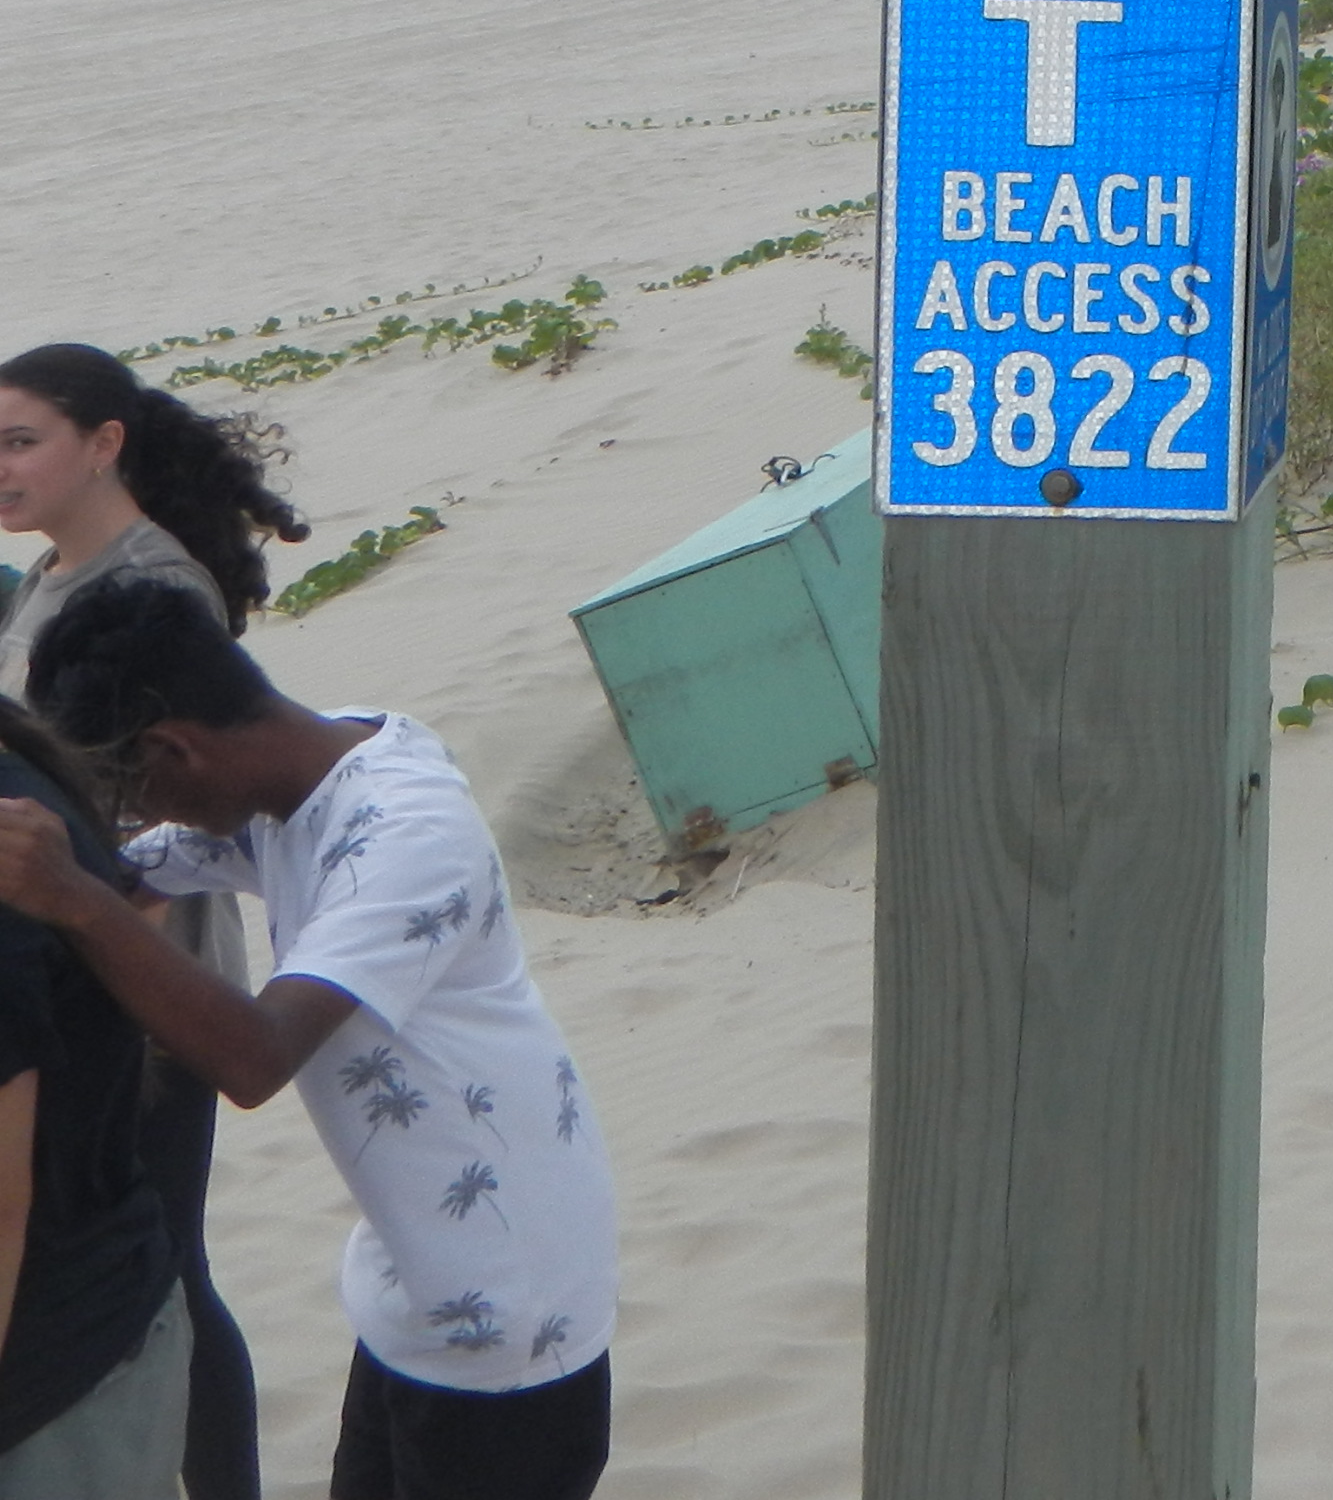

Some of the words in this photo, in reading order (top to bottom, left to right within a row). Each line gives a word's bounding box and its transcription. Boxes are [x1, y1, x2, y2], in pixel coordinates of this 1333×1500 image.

[942, 169, 1194, 248] BEACH
[915, 260, 1211, 335] ACCESS
[911, 349, 1211, 470] 3822
